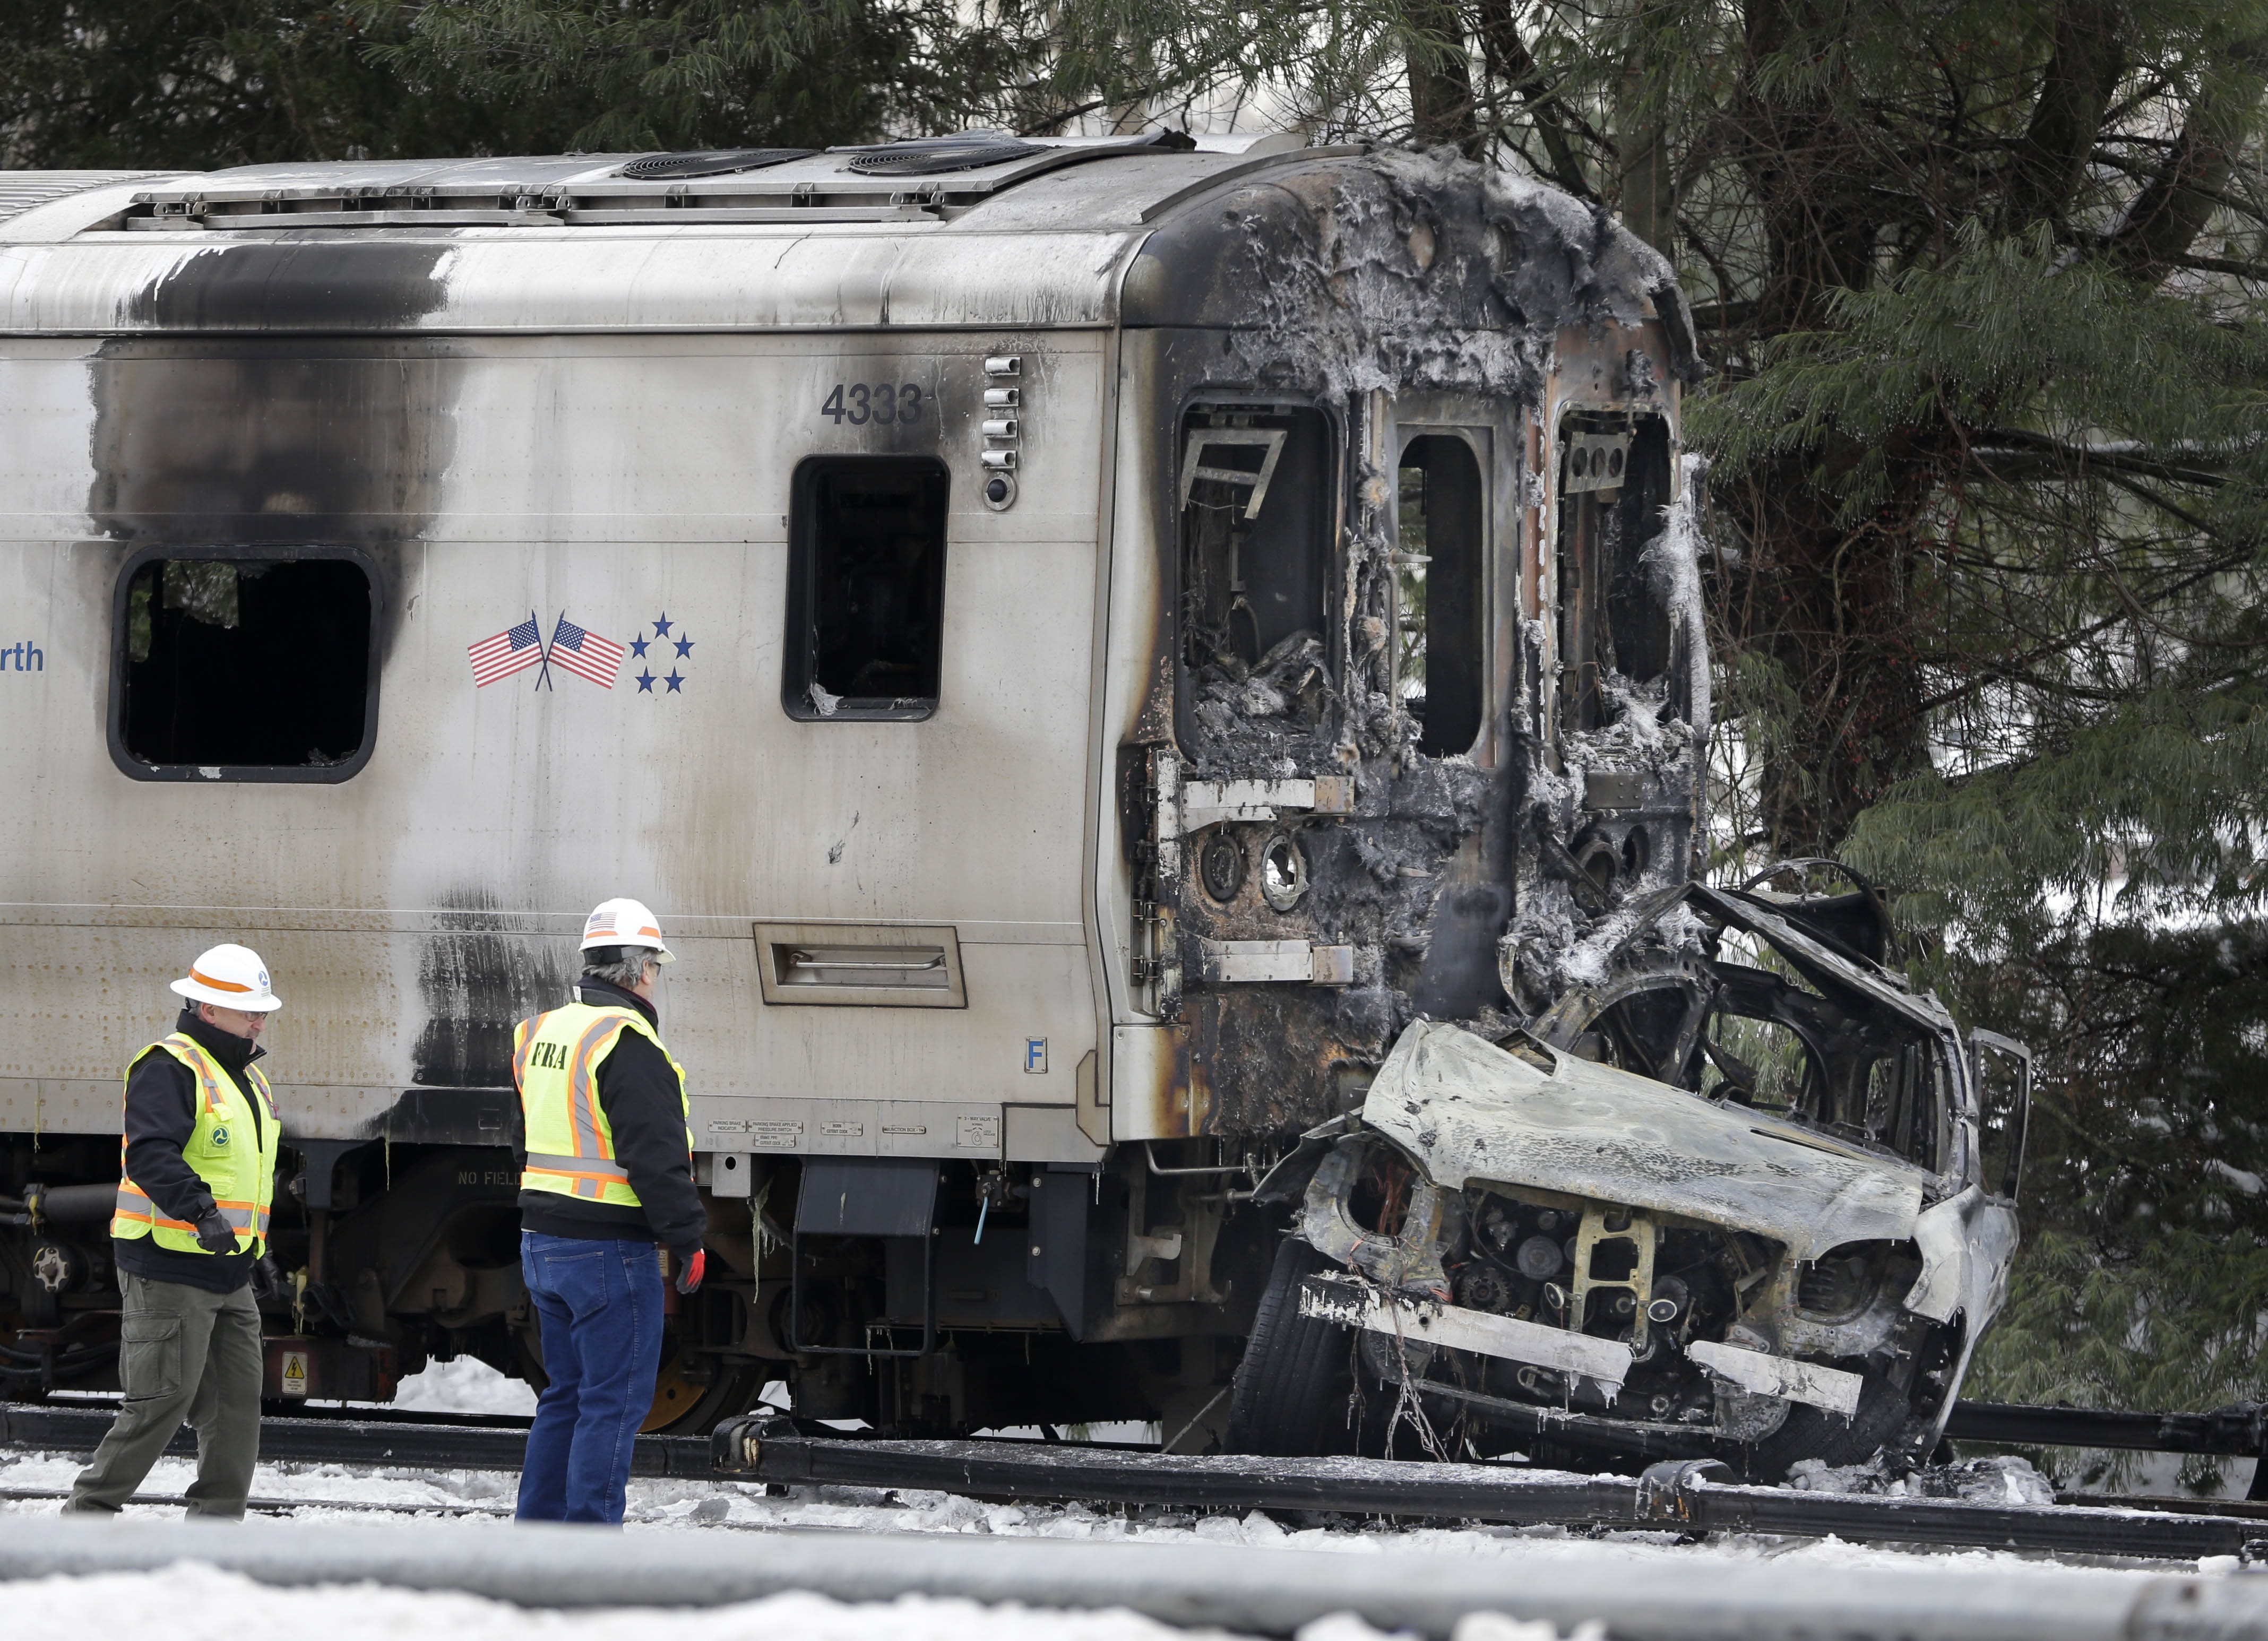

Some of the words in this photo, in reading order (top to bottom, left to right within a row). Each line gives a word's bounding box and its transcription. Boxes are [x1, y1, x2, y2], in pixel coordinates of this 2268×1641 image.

[822, 383, 922, 425] 4333
[0, 641, 43, 671] rth
[531, 1042, 567, 1070] FRA
[1029, 1041, 1044, 1068] F
[459, 1172, 477, 1185] NO
